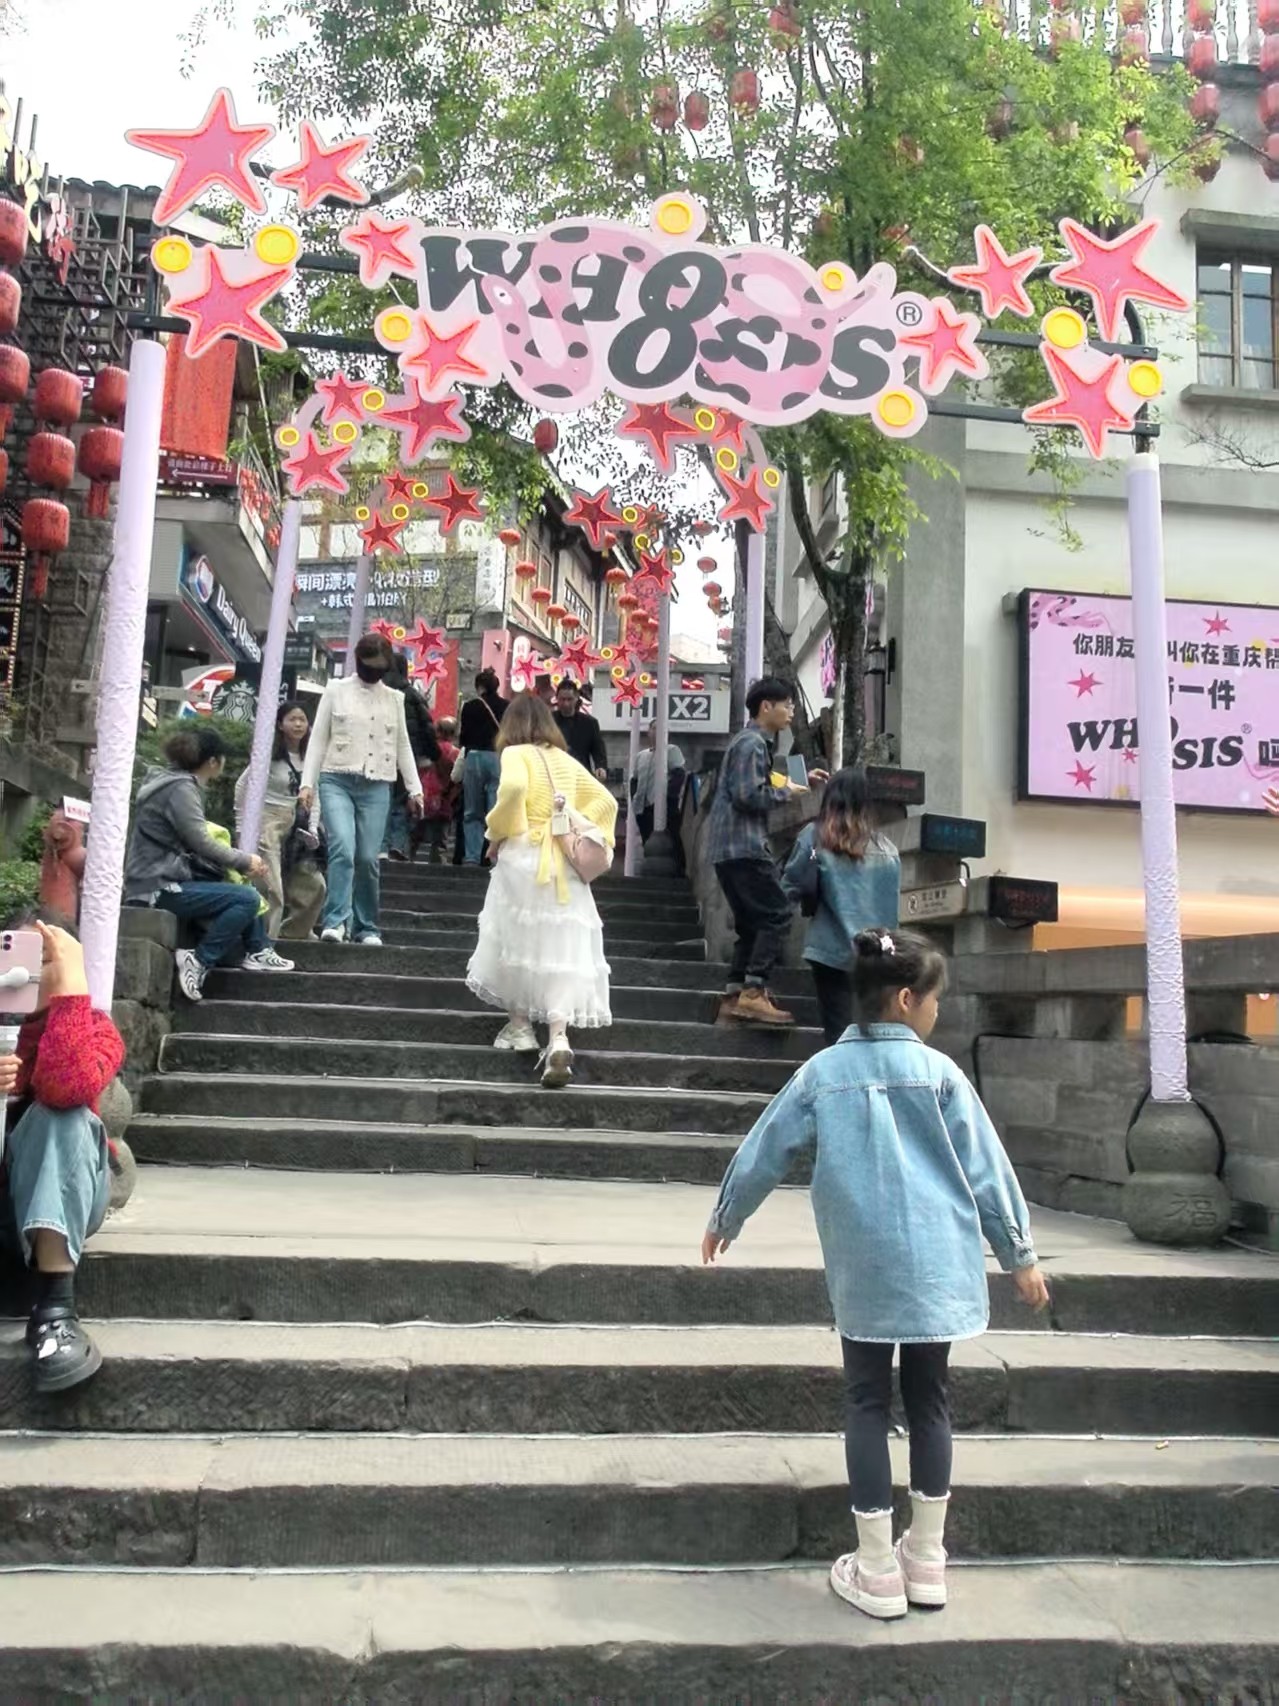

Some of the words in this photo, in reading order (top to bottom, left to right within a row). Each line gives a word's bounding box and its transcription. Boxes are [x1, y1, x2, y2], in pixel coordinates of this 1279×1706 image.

[216, 583, 240, 639] Dairy
[669, 694, 711, 720] X2
[1167, 675, 1237, 711] 一件
[1066, 716, 1244, 770] WHSIS
